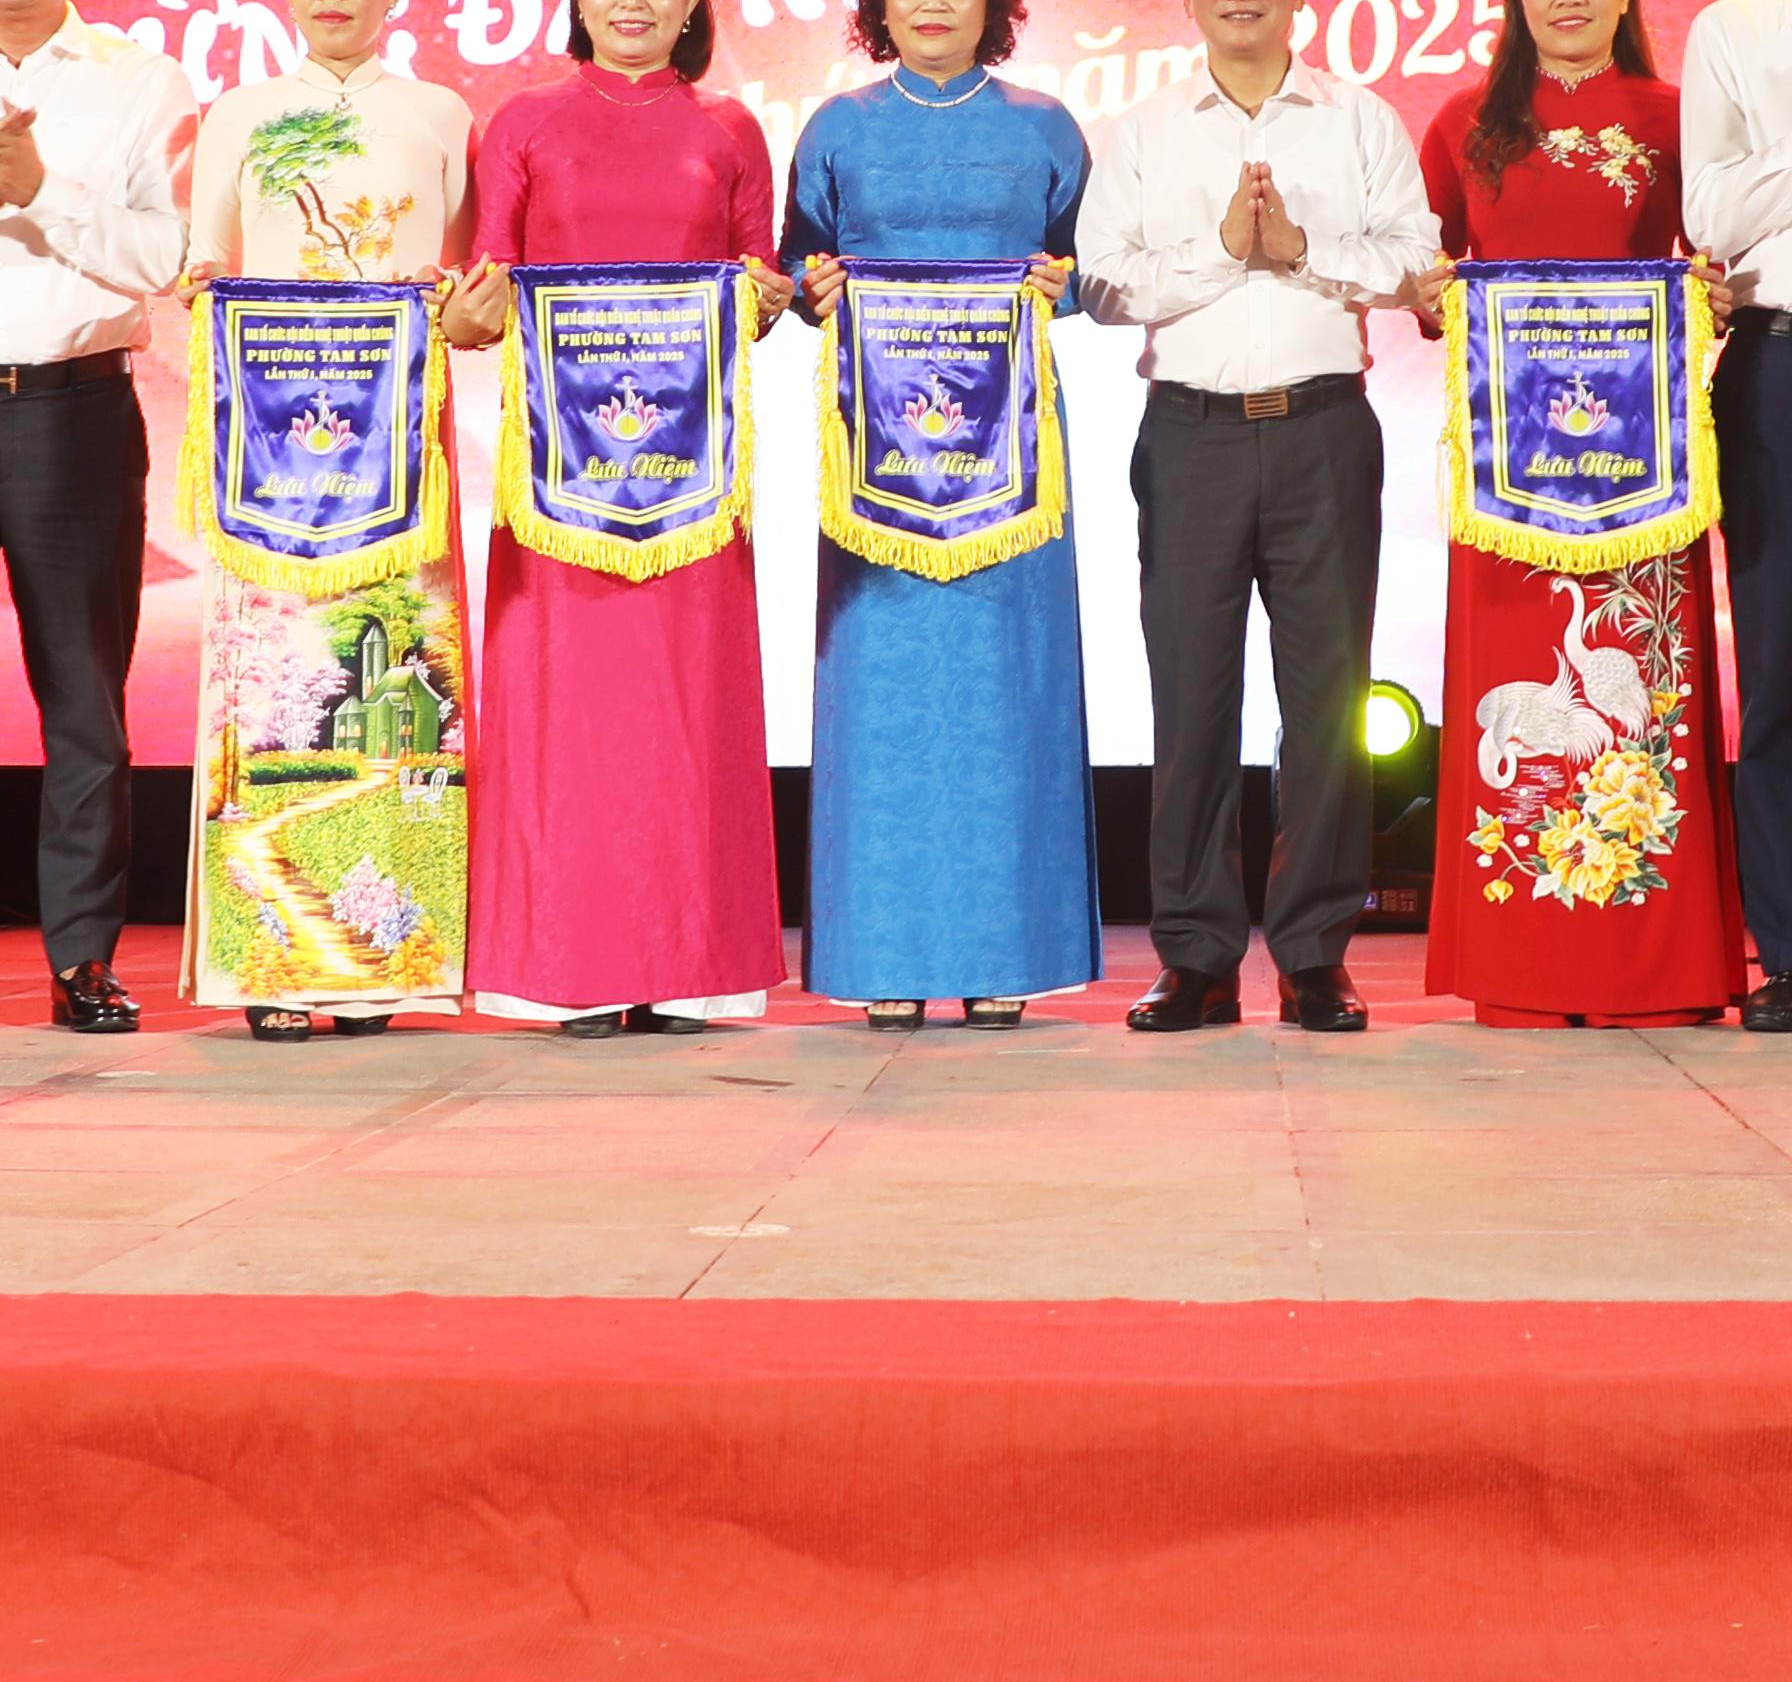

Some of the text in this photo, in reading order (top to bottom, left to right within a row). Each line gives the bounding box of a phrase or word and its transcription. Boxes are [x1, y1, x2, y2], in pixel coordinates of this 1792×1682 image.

[558, 329, 702, 346] PHƯỜNG TAM SƠN
[867, 327, 1008, 343] PHƯỜNG TAM SƠN
[1508, 327, 1648, 342] PHƯỜNG TAM SƠN
[246, 347, 391, 362] PHƯỜNG TAM SƠN
